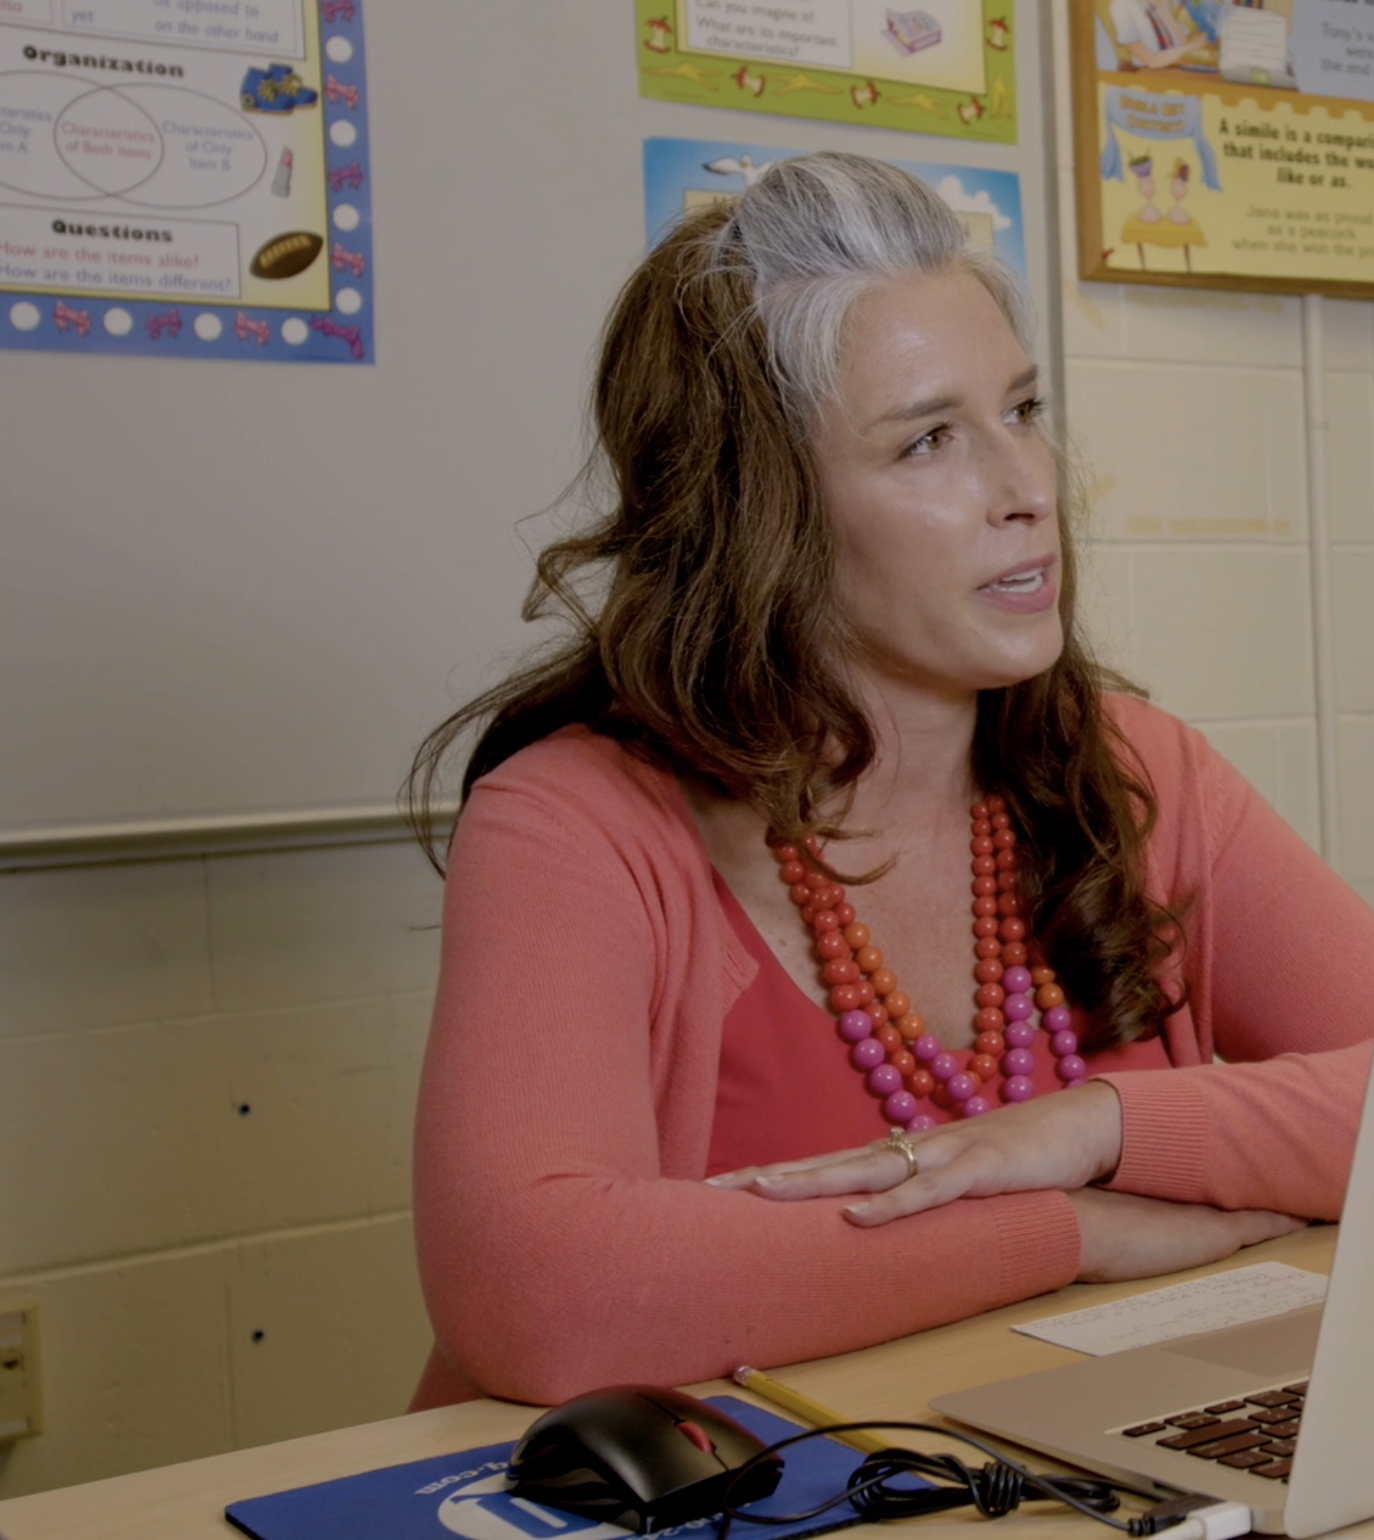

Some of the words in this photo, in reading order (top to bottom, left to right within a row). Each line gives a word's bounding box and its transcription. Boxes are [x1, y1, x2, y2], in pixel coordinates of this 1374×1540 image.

[71, 9, 95, 25] yet
[177, 0, 238, 15] opposed
[245, 4, 259, 18] to
[725, 2, 747, 14] you
[752, 4, 797, 21] imagine
[154, 19, 172, 33] on
[177, 17, 199, 36] the
[204, 20, 240, 40] other
[245, 25, 279, 44] hand
[695, 15, 731, 32] What
[735, 24, 756, 36] are
[778, 29, 838, 47] important
[1321, 21, 1363, 43] Tony's
[706, 34, 800, 57] characteristics?
[1345, 47, 1374, 59] were
[21, 43, 185, 79] Organization
[1321, 57, 1342, 72] the
[1346, 63, 1370, 76] end
[0, 105, 51, 123] teristics
[60, 120, 156, 143] Characteristics
[161, 119, 254, 142] Characteristics
[1218, 117, 1230, 135] A
[1234, 120, 1280, 140] simile
[1285, 124, 1298, 142] is
[1302, 130, 1312, 143] a
[65, 140, 80, 155] of
[83, 140, 112, 156] Both
[186, 139, 200, 153] of
[202, 140, 232, 157] Only
[1222, 140, 1254, 160] that
[1258, 143, 1321, 166] includes
[1325, 150, 1349, 168] the
[1276, 166, 1305, 186] like
[1308, 172, 1325, 187] or
[1330, 174, 1352, 189] as.
[1284, 210, 1310, 222] was
[1314, 211, 1330, 223] as
[1333, 212, 1374, 227] proud
[51, 217, 174, 244] Questions
[1267, 225, 1283, 237] as
[1287, 225, 1296, 237] a
[1299, 226, 1357, 241] peacock
[42, 247, 69, 261] are
[74, 245, 100, 264] the
[107, 248, 151, 267] items
[157, 251, 200, 270] alike?
[43, 267, 70, 282] are
[76, 267, 102, 285] the
[108, 270, 153, 288] items
[159, 272, 231, 292] different?
